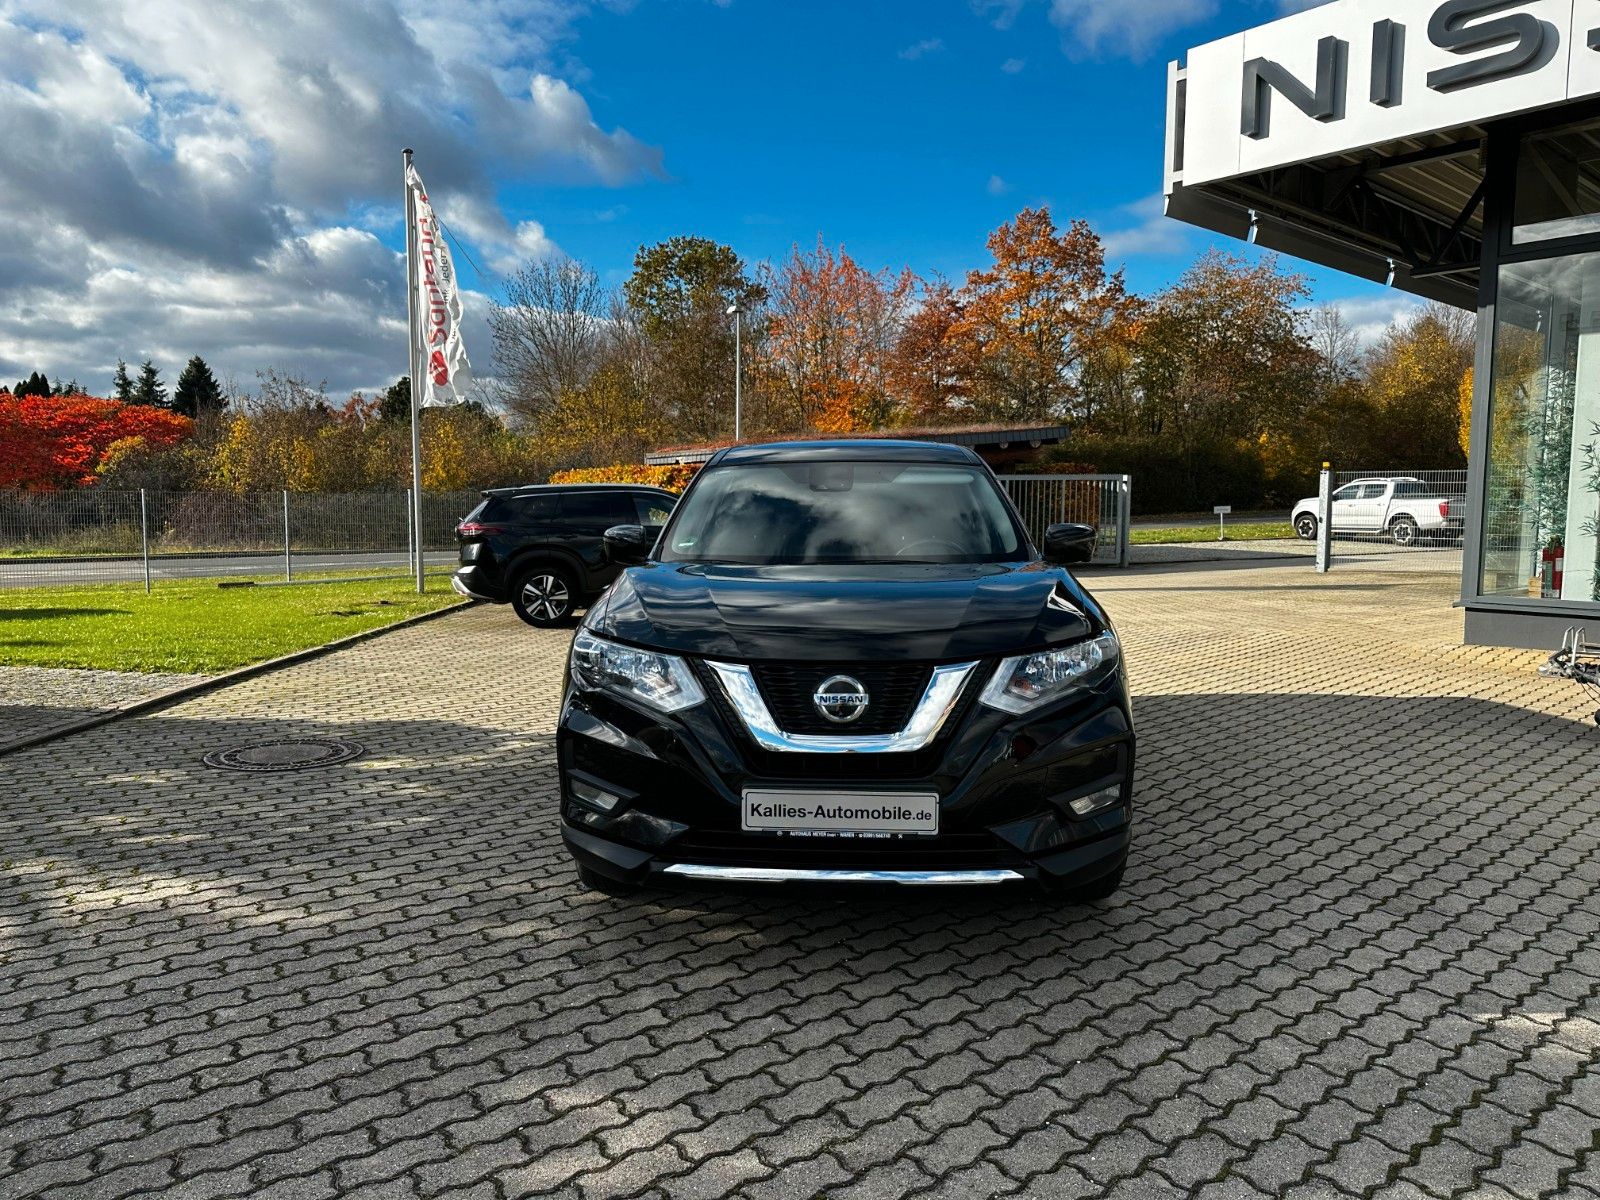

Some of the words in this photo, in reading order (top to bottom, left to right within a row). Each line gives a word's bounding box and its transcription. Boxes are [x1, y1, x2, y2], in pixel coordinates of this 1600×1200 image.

[1240, 0, 1600, 140] NIS
[820, 695, 863, 703] NISSAN
[750, 803, 932, 821] Kallies-Automobile.de
